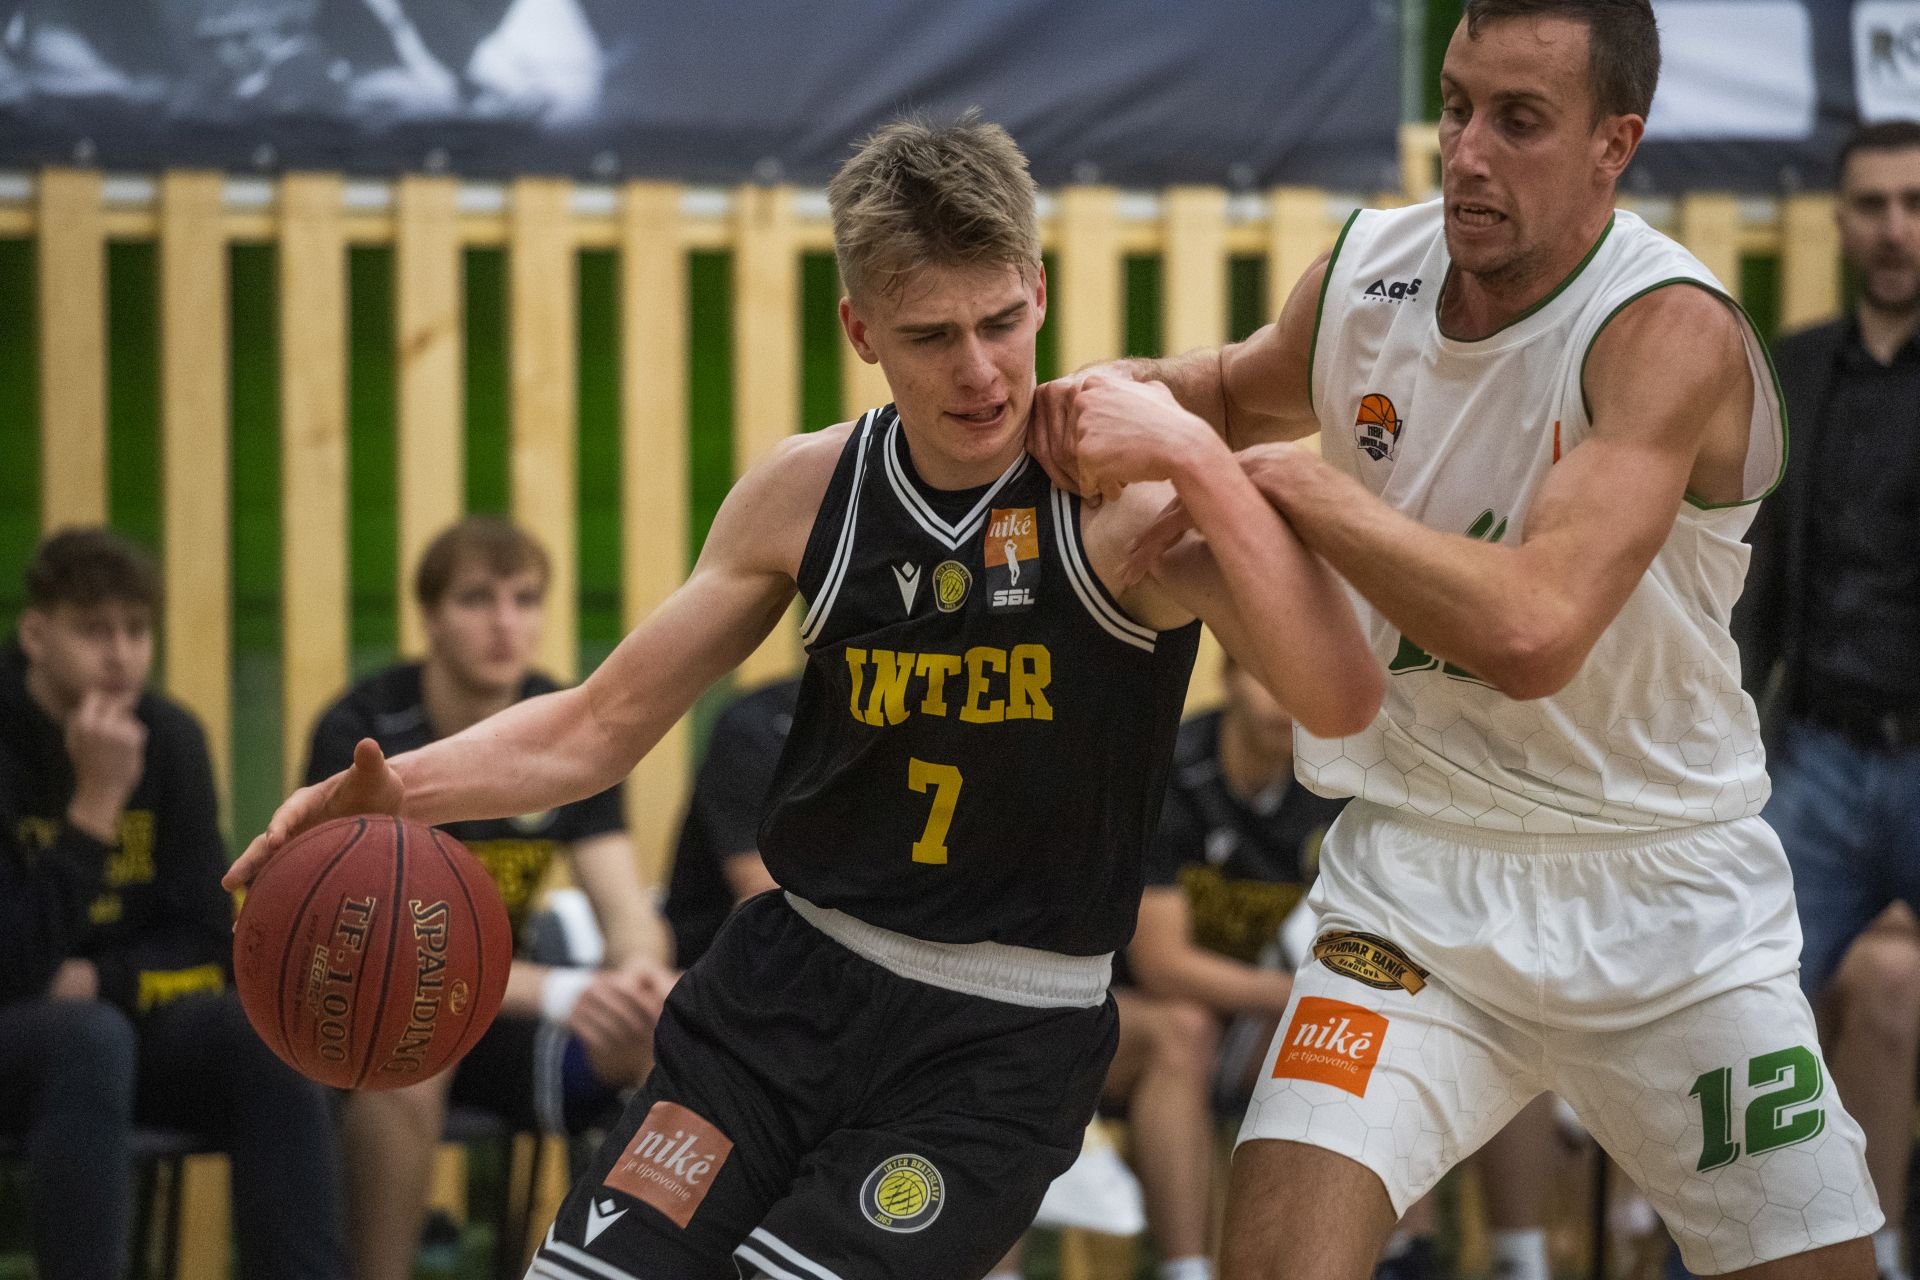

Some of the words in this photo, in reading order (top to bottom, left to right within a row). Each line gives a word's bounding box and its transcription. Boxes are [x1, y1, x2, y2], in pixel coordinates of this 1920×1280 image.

[989, 514, 1032, 538] niké
[992, 588, 1035, 607] SBL
[845, 643, 1053, 727] INTER
[908, 757, 963, 865] 7
[319, 896, 377, 1064] TF-1000
[377, 899, 449, 1074] SPALDING
[1292, 1017, 1373, 1060] niké
[1285, 1050, 1299, 1063] je
[1300, 1051, 1360, 1075] tipovanie
[1688, 1045, 1825, 1174] 12
[632, 1130, 717, 1186] niké
[883, 1158, 909, 1173] INTER
[621, 1159, 635, 1172] je
[635, 1162, 693, 1201] tipovanie
[874, 1212, 893, 1226] 1963
